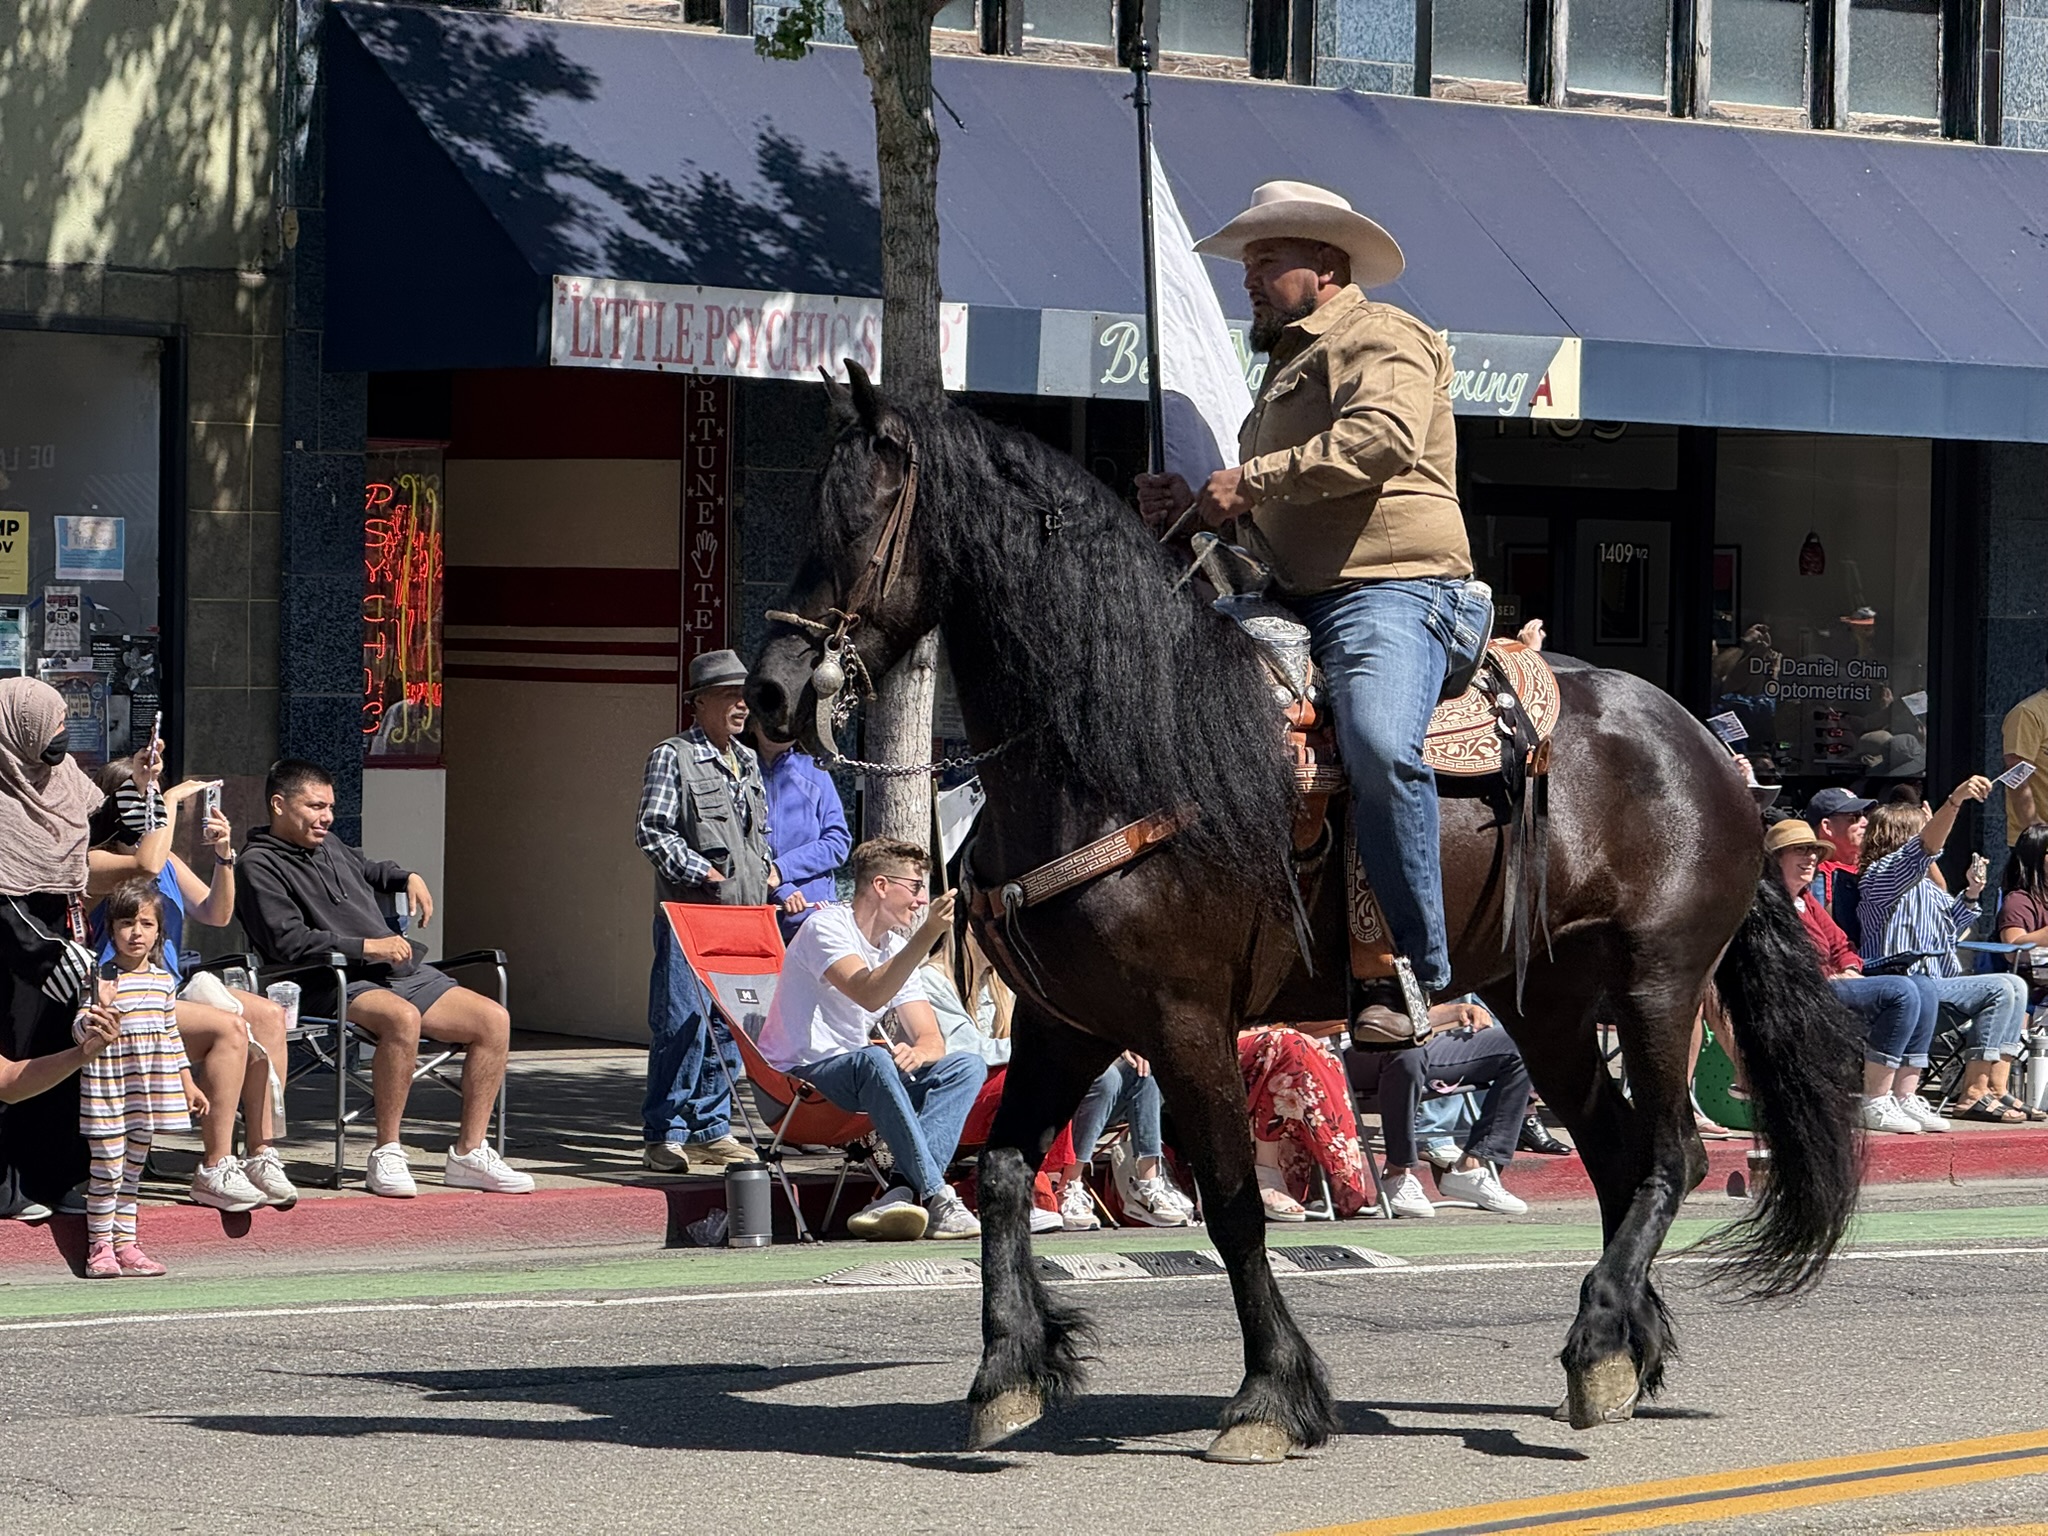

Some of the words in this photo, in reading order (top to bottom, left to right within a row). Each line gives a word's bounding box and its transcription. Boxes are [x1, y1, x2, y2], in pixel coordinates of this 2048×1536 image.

[569, 295, 694, 365] LITTLE
[1449, 345, 1529, 416] axing
[694, 376, 717, 525] RTUNE
[1600, 543, 1633, 563] 1409
[693, 583, 713, 656] TEL
[1496, 605, 1515, 617] SED
[1750, 658, 1773, 675] Dr.
[1783, 659, 1839, 677] Daniel
[1847, 660, 1888, 679] Chin
[1765, 680, 1871, 701] Optometrist
